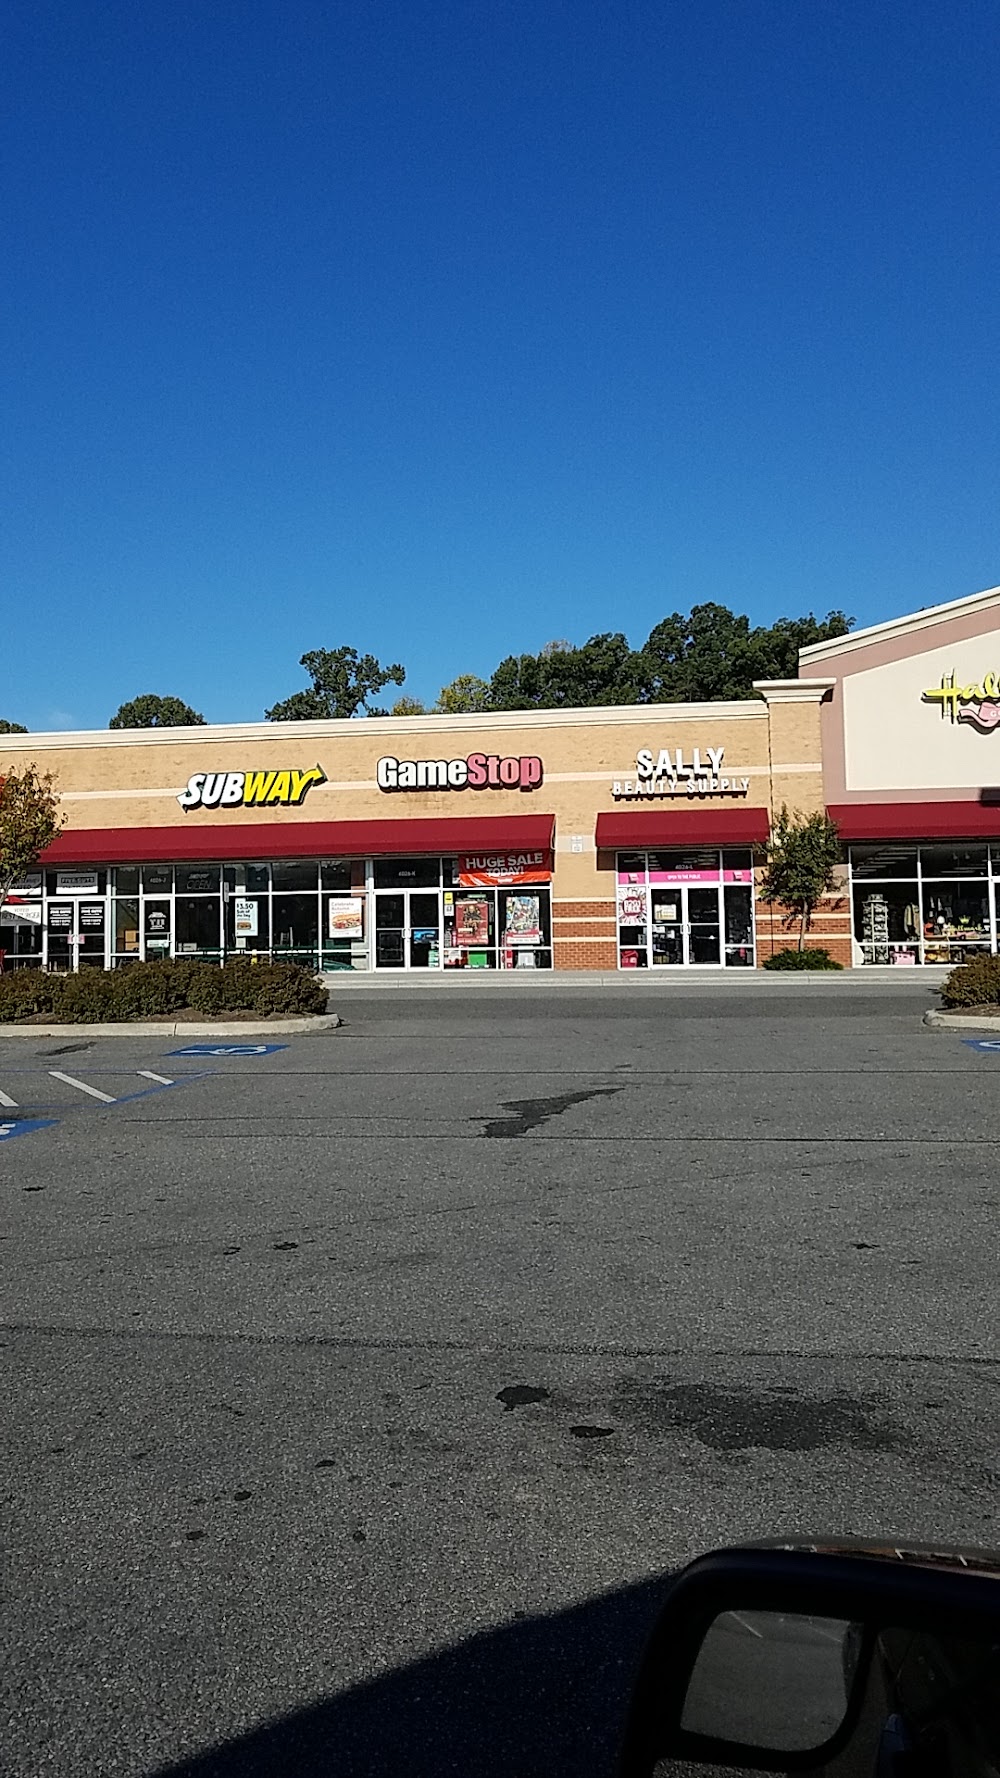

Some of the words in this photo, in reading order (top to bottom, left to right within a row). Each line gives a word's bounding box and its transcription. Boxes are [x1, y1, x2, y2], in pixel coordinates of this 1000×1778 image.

[922, 668, 1000, 718] Hal
[377, 753, 543, 791] GameStop
[636, 747, 725, 778] SALLY
[177, 764, 327, 812] SUBWAY
[612, 780, 677, 796] BEAUTY
[686, 777, 750, 794] SUPPLY
[465, 856, 506, 870] HUGE
[507, 852, 543, 866] SALE
[486, 865, 524, 878] TODAY!
